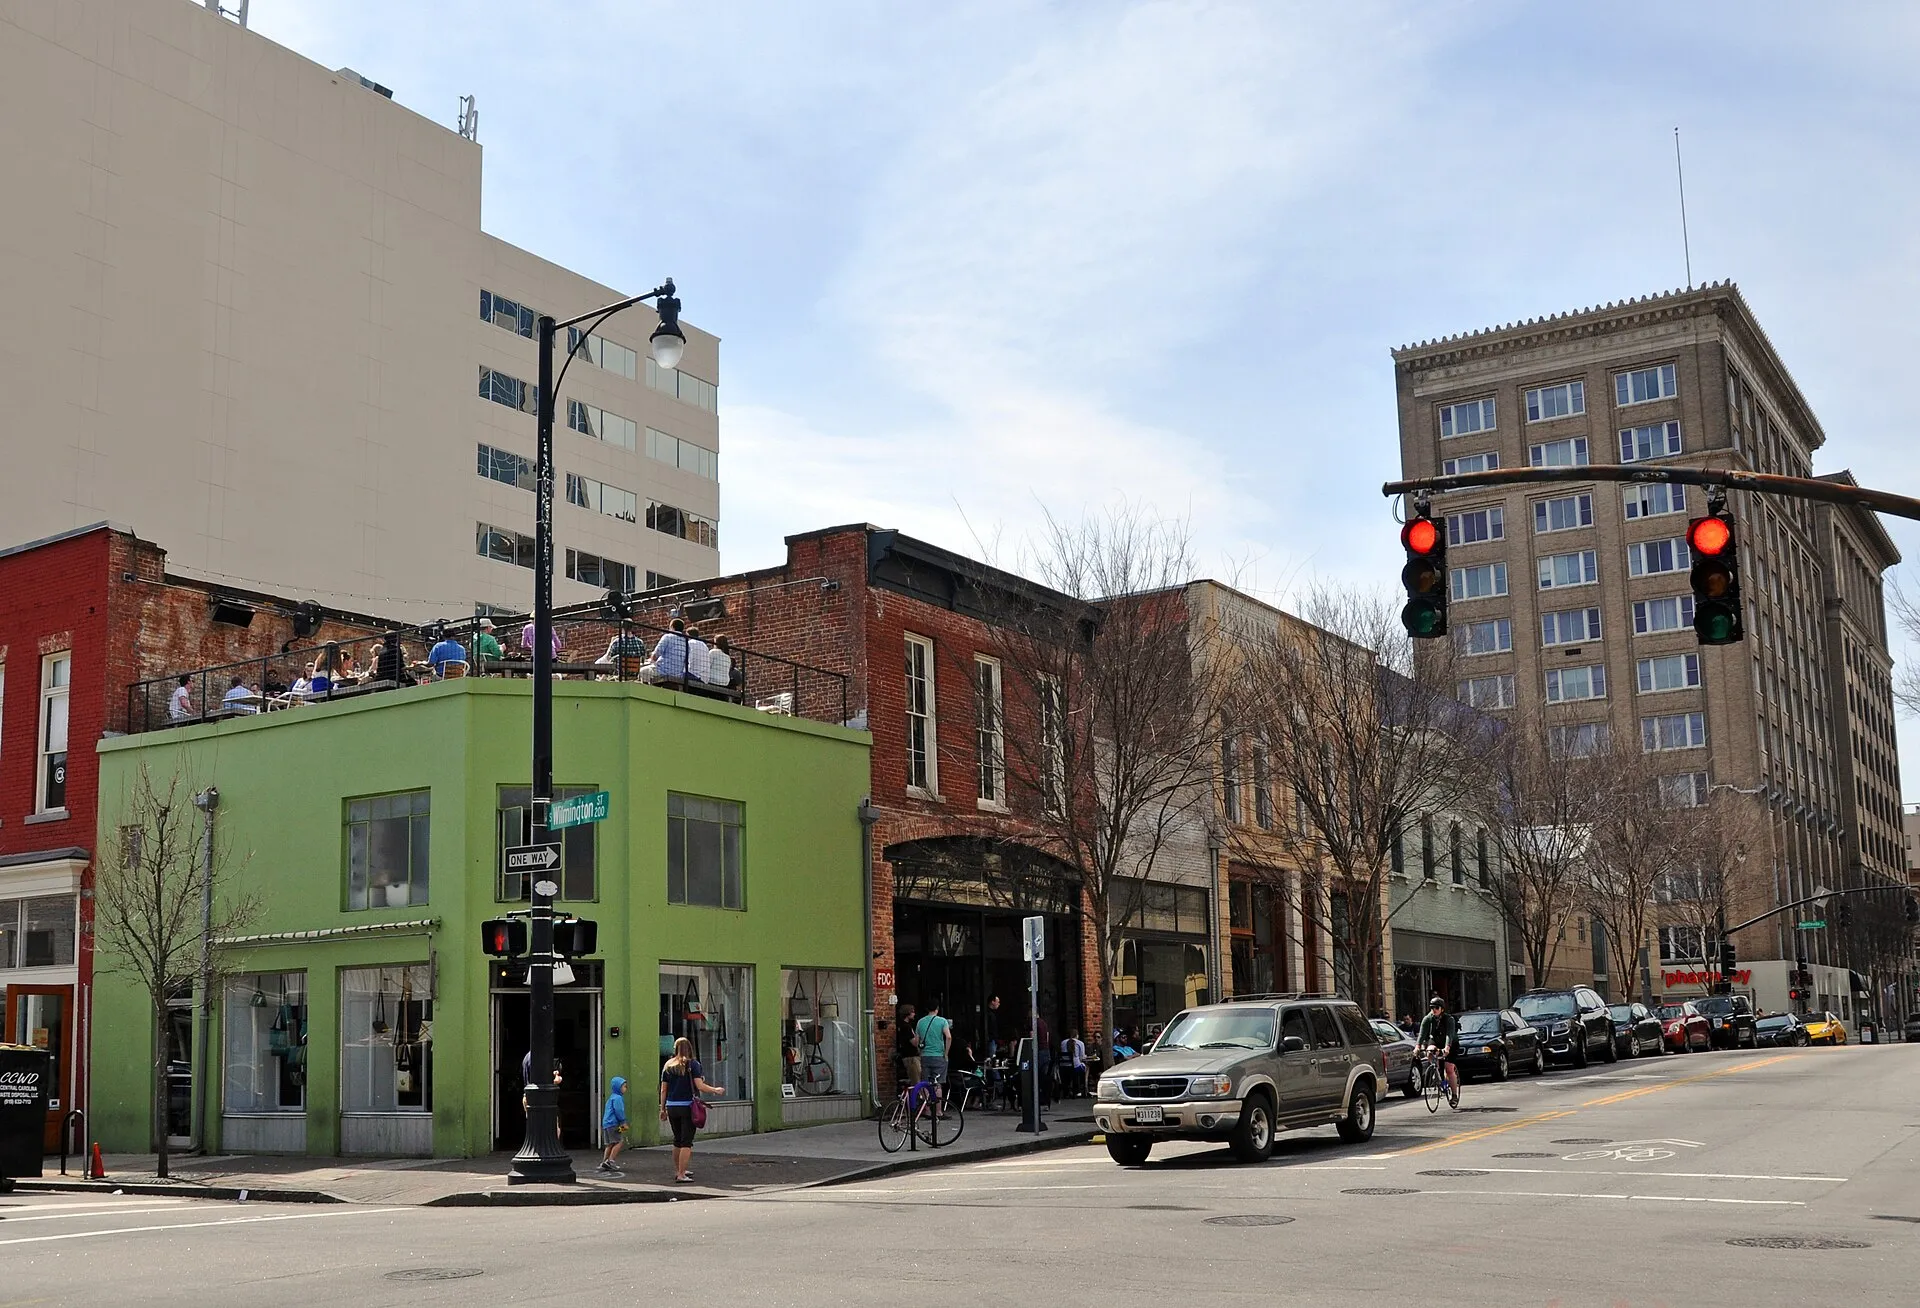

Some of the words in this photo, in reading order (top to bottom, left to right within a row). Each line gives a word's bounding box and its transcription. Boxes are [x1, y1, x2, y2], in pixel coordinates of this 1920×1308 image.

[553, 801, 594, 825] Wilmington
[597, 795, 603, 806] ST
[594, 806, 605, 818] 200
[511, 855, 527, 865] ONE
[532, 853, 549, 863] WAY
[877, 973, 891, 985] FDC
[0, 1072, 39, 1084] CCWD
